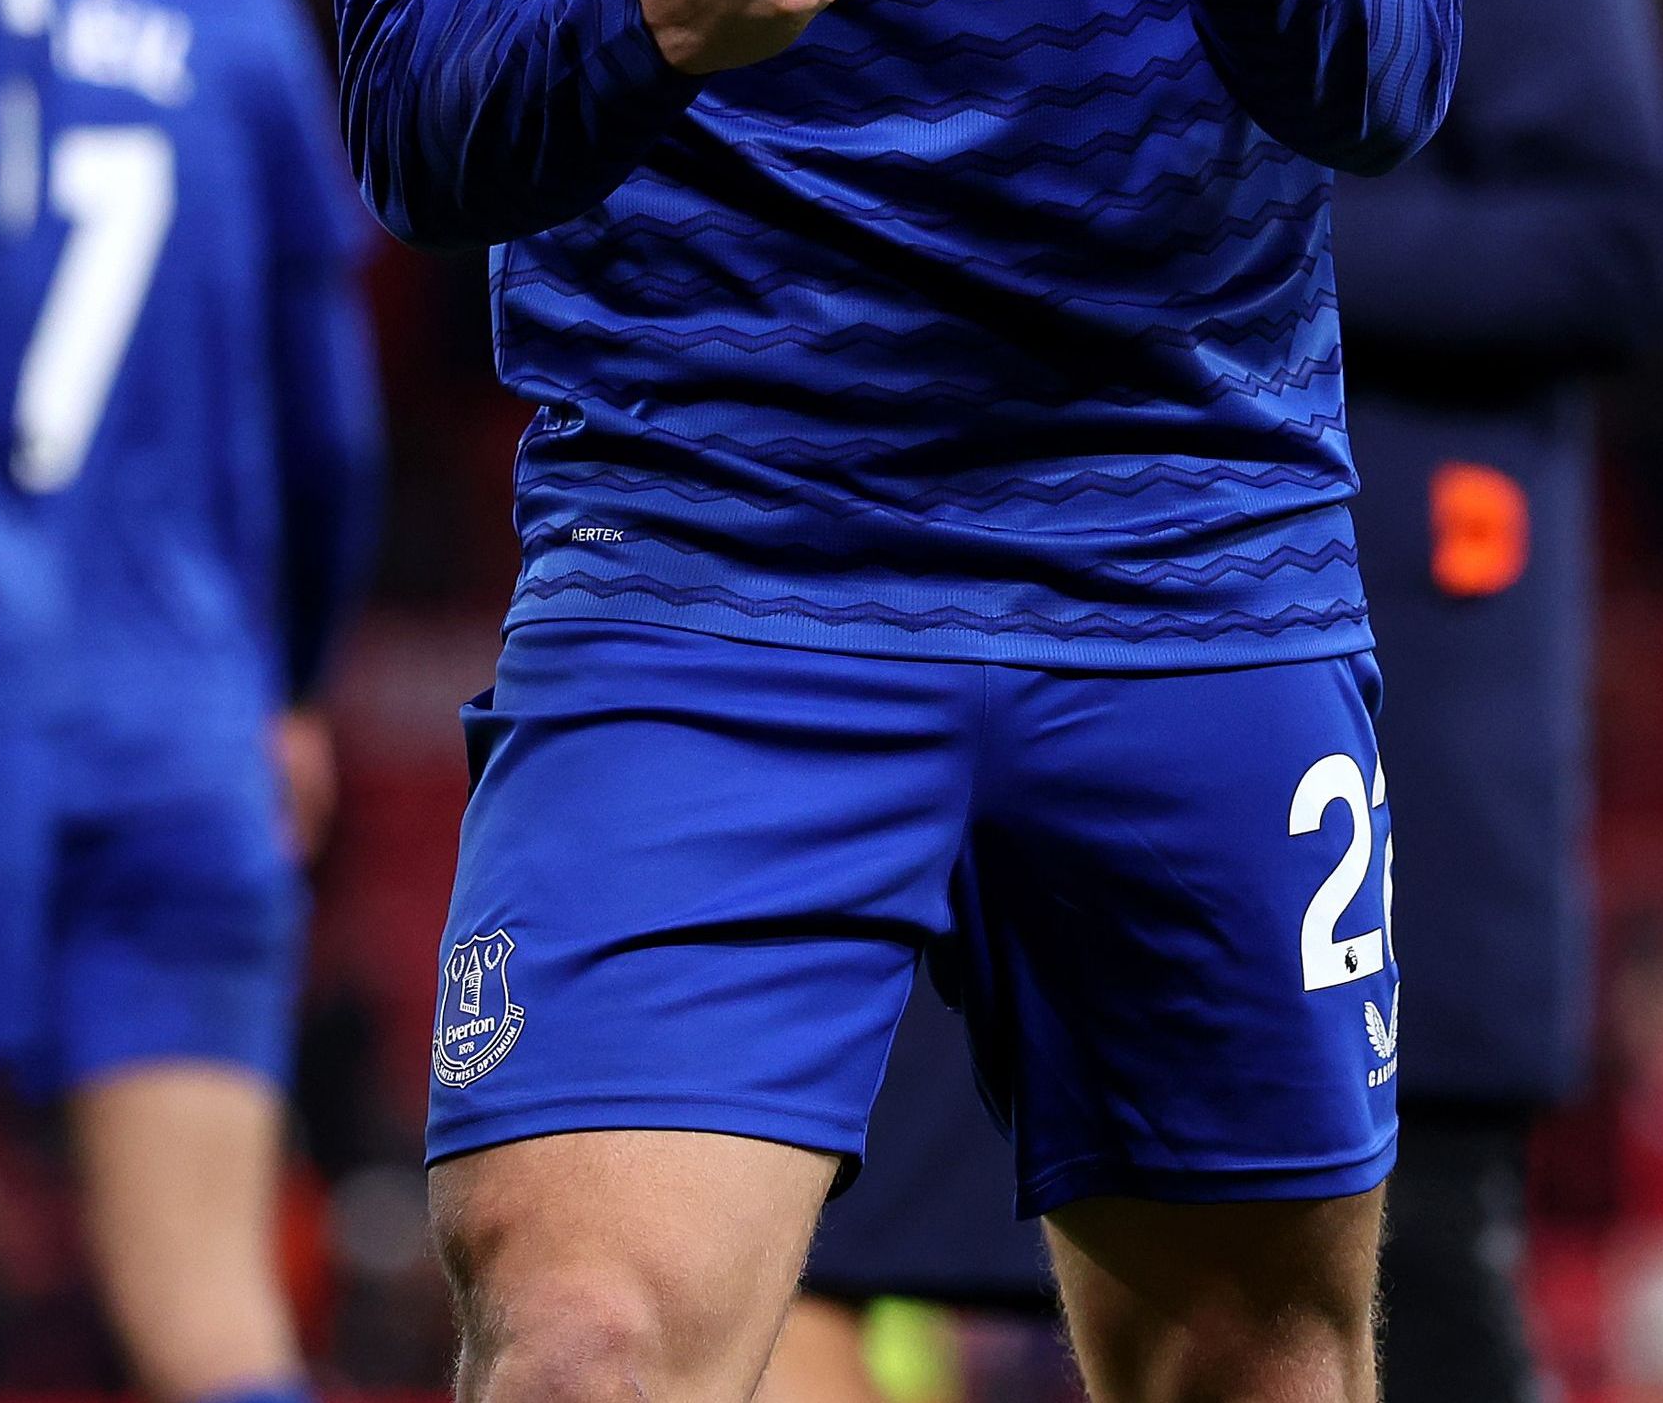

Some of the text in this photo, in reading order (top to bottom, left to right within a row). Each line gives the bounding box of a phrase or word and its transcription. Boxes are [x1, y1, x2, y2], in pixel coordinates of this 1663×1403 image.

[11, 121, 178, 496] 7
[571, 528, 624, 542] AERTEK
[1288, 753, 1393, 992] 2
[445, 1017, 495, 1046] Everton
[477, 1026, 517, 1072] OPTIMUM
